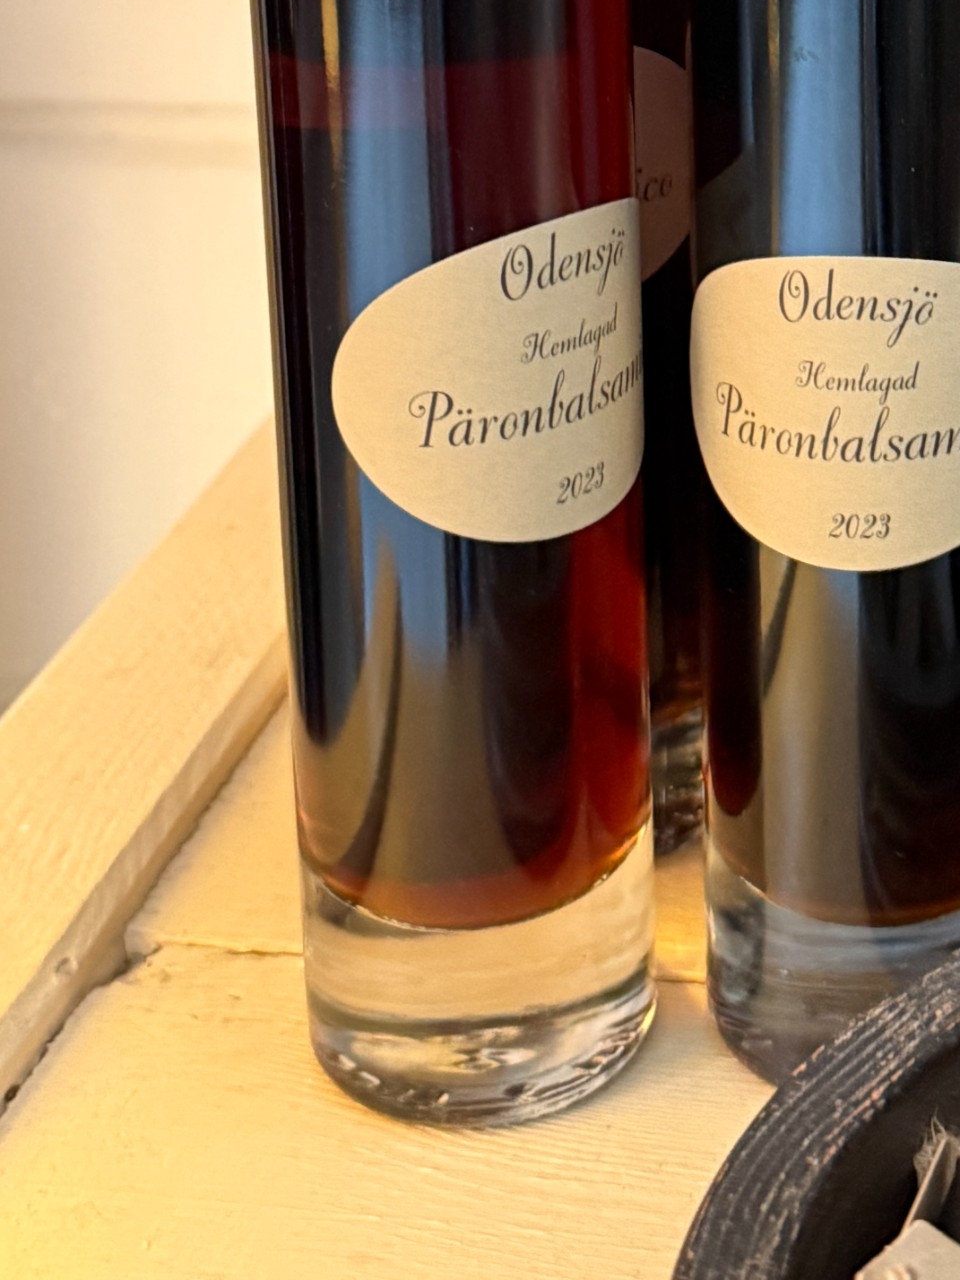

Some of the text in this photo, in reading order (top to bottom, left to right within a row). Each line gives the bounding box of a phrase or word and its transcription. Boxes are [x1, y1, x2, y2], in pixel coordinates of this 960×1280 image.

[500, 228, 626, 301] Odensjö
[520, 302, 619, 364] Hemlagad
[778, 268, 938, 348] Odensjö
[796, 360, 921, 405] Hemlagad
[556, 461, 606, 505] 2023
[828, 513, 893, 540] 2023
